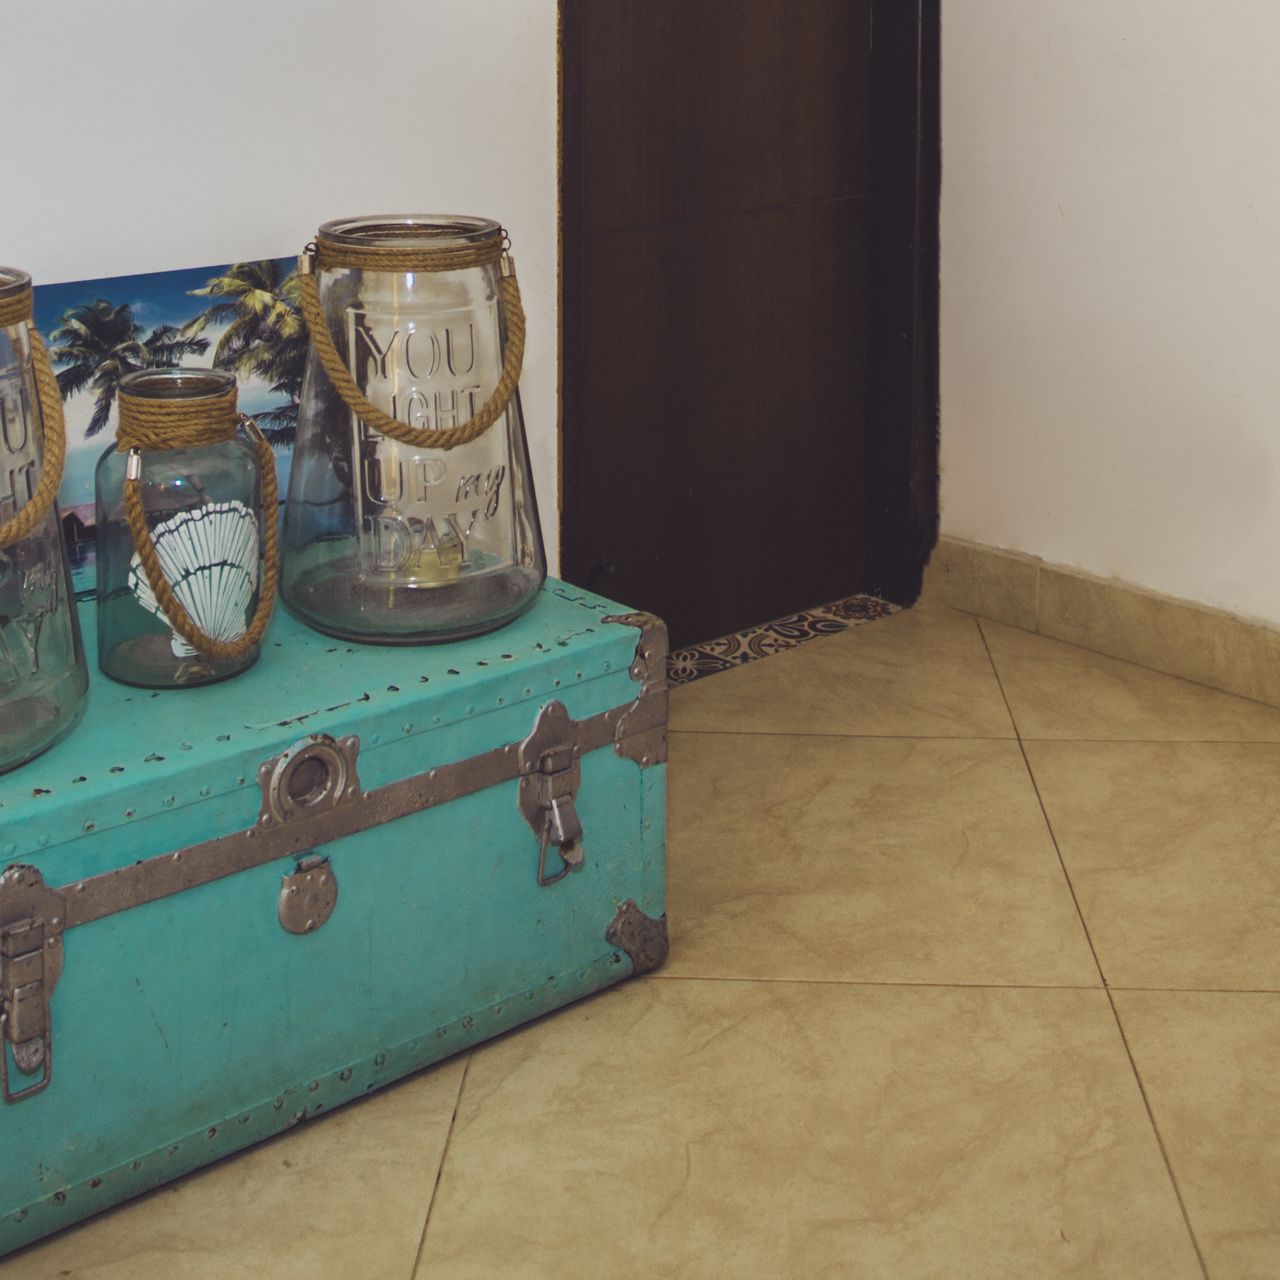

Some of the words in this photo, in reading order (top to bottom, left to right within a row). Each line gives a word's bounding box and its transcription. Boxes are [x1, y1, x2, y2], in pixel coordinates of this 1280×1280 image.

[356, 324, 476, 380] YOU
[365, 458, 447, 506] UP
[455, 465, 505, 520] my
[363, 509, 480, 571] DAY
